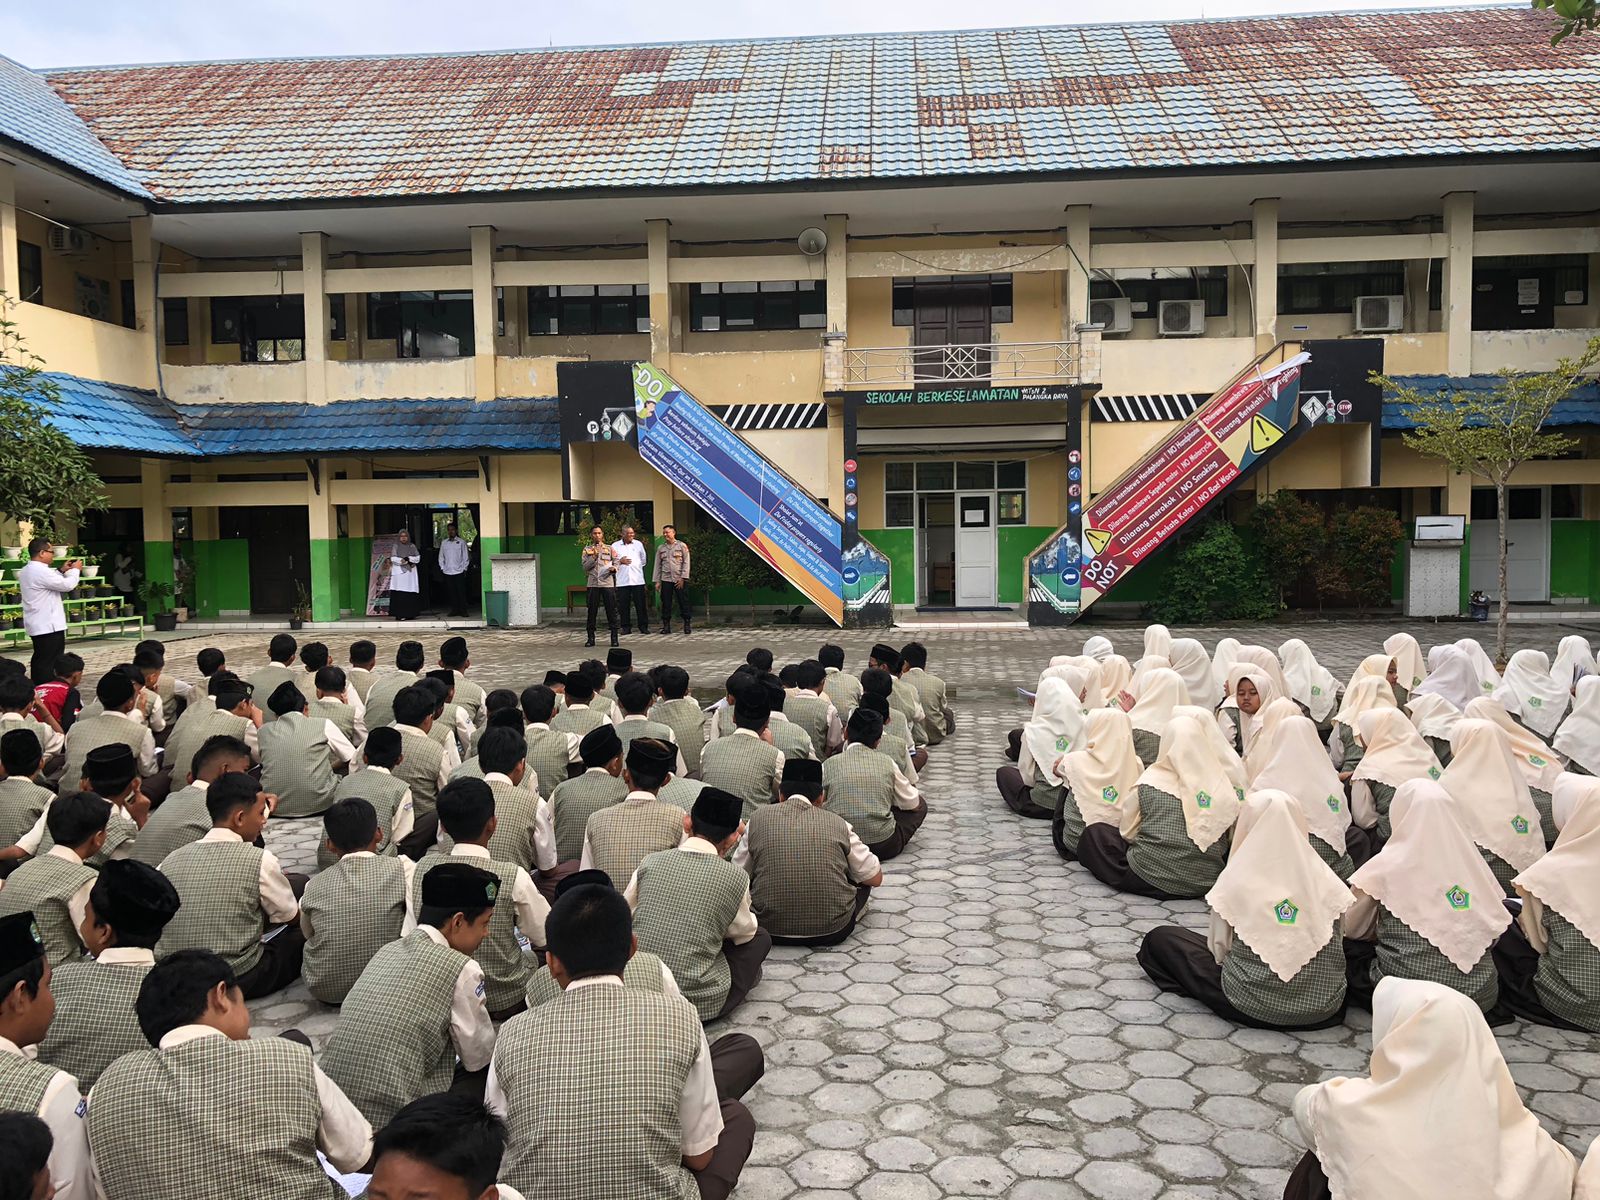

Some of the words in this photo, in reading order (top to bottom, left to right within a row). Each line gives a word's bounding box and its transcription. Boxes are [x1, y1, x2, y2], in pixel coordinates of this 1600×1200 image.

[635, 368, 662, 396] DO
[866, 392, 912, 404] SEKOLAH
[917, 389, 1018, 402] BERKESELAMATAN
[1202, 404, 1224, 424] Dilarang
[1222, 385, 1247, 407] membawa
[1215, 416, 1240, 437] Dilarang
[1237, 394, 1264, 418] Berkelahi
[662, 415, 672, 426] Pray
[670, 423, 685, 436] before
[683, 433, 701, 450] studying
[667, 409, 682, 423] Berdoa
[680, 420, 698, 436] sebelum
[696, 434, 711, 447] belajar
[643, 438, 658, 453] Khatam
[692, 480, 706, 492] pekan
[669, 447, 684, 460] prayer
[682, 458, 702, 476] everyday
[1095, 497, 1117, 516] Dilarang
[1114, 477, 1140, 500] membawa
[1138, 456, 1165, 480] Handphone
[1167, 445, 1177, 456] NO
[1175, 426, 1200, 448] Handphone
[1107, 512, 1128, 530] Dilarang
[1126, 493, 1151, 514] membawa
[1148, 479, 1166, 496] Sepeda
[1164, 468, 1179, 483] motor
[1181, 458, 1191, 469] NO
[1188, 440, 1213, 462] Motorcycle
[1119, 518, 1148, 543] Dilarang
[1146, 495, 1176, 521] merokok
[1180, 480, 1194, 493] NO
[1191, 460, 1218, 483] Smoking
[778, 504, 791, 516] Sholat
[805, 513, 818, 524] prayer
[816, 522, 834, 538] together
[1132, 534, 1158, 557] Dilarang
[1155, 517, 1178, 537] Berkata
[1176, 503, 1194, 519] Kotor
[1197, 490, 1209, 502] NO
[1207, 480, 1220, 493] Bad
[1218, 467, 1236, 483] Words
[779, 515, 793, 528] Friday
[791, 525, 806, 539] prayers
[804, 536, 823, 553] regularly
[1084, 560, 1102, 581] DO
[1096, 560, 1118, 589] NOT
